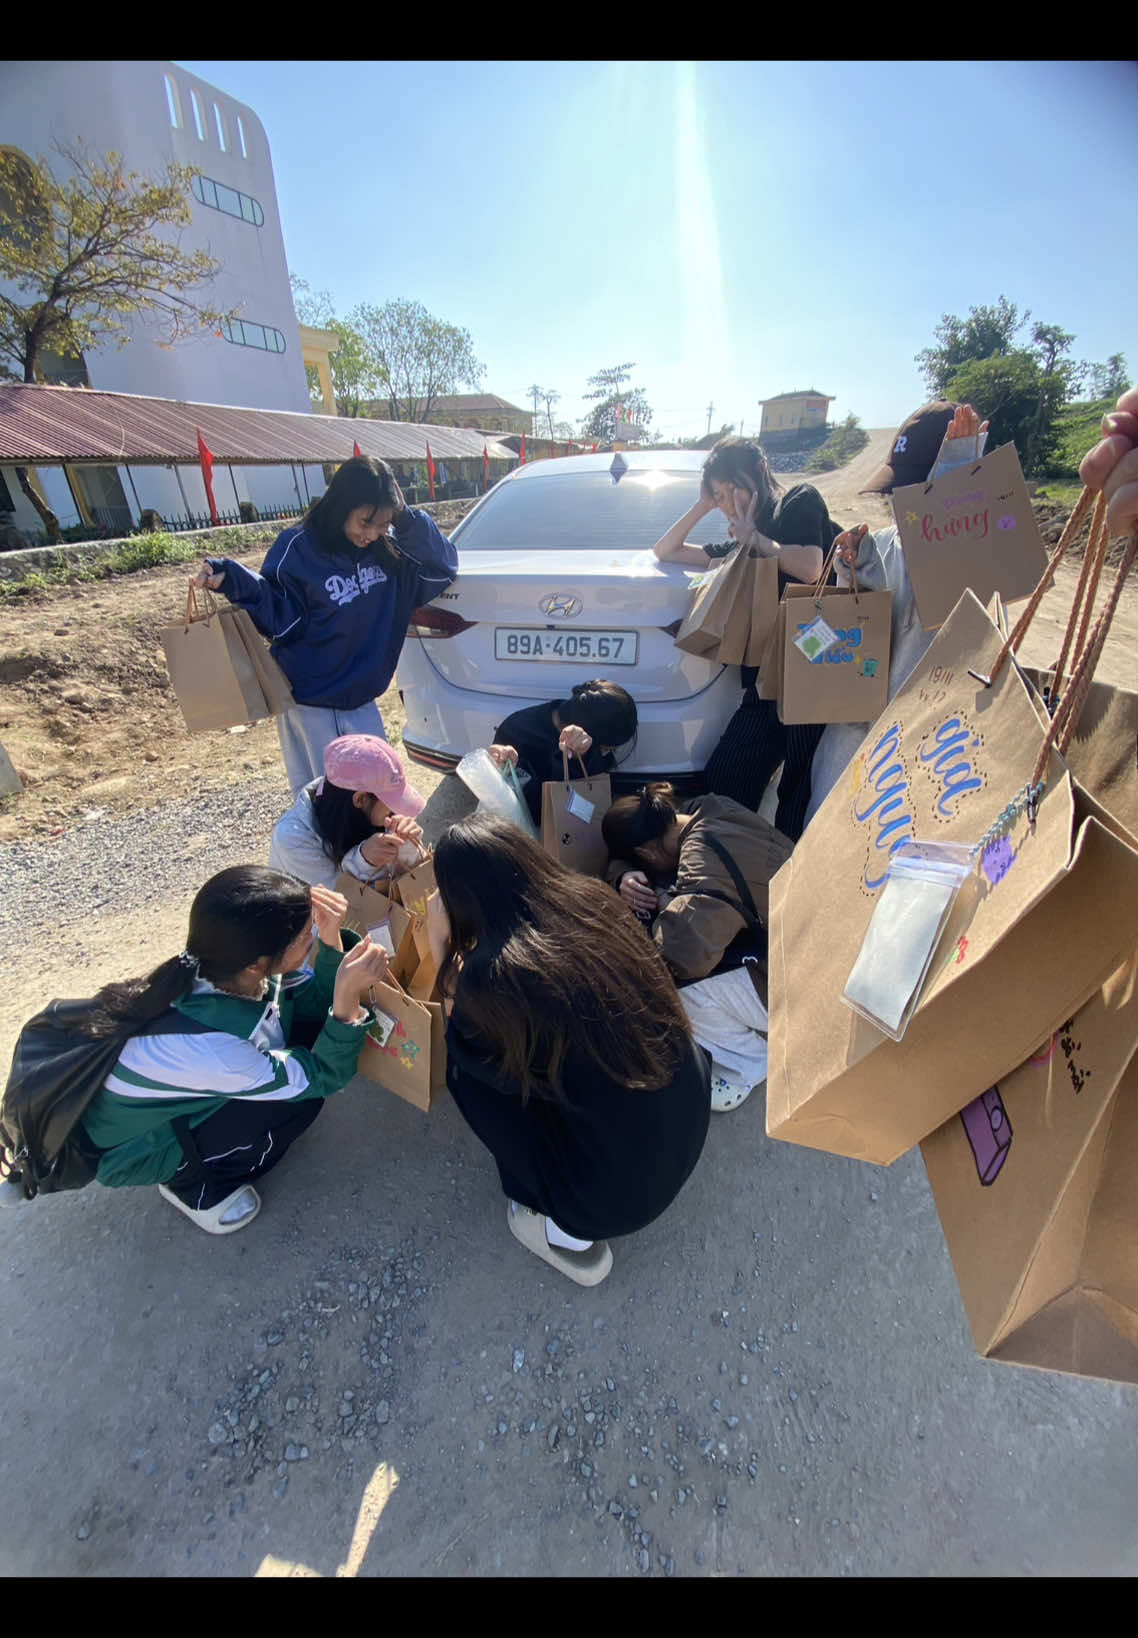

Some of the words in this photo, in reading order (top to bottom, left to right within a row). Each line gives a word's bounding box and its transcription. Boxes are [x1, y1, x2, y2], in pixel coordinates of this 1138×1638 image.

[894, 436, 907, 452] R
[507, 634, 624, 659] 89A-405.67
[921, 718, 981, 815] gia
